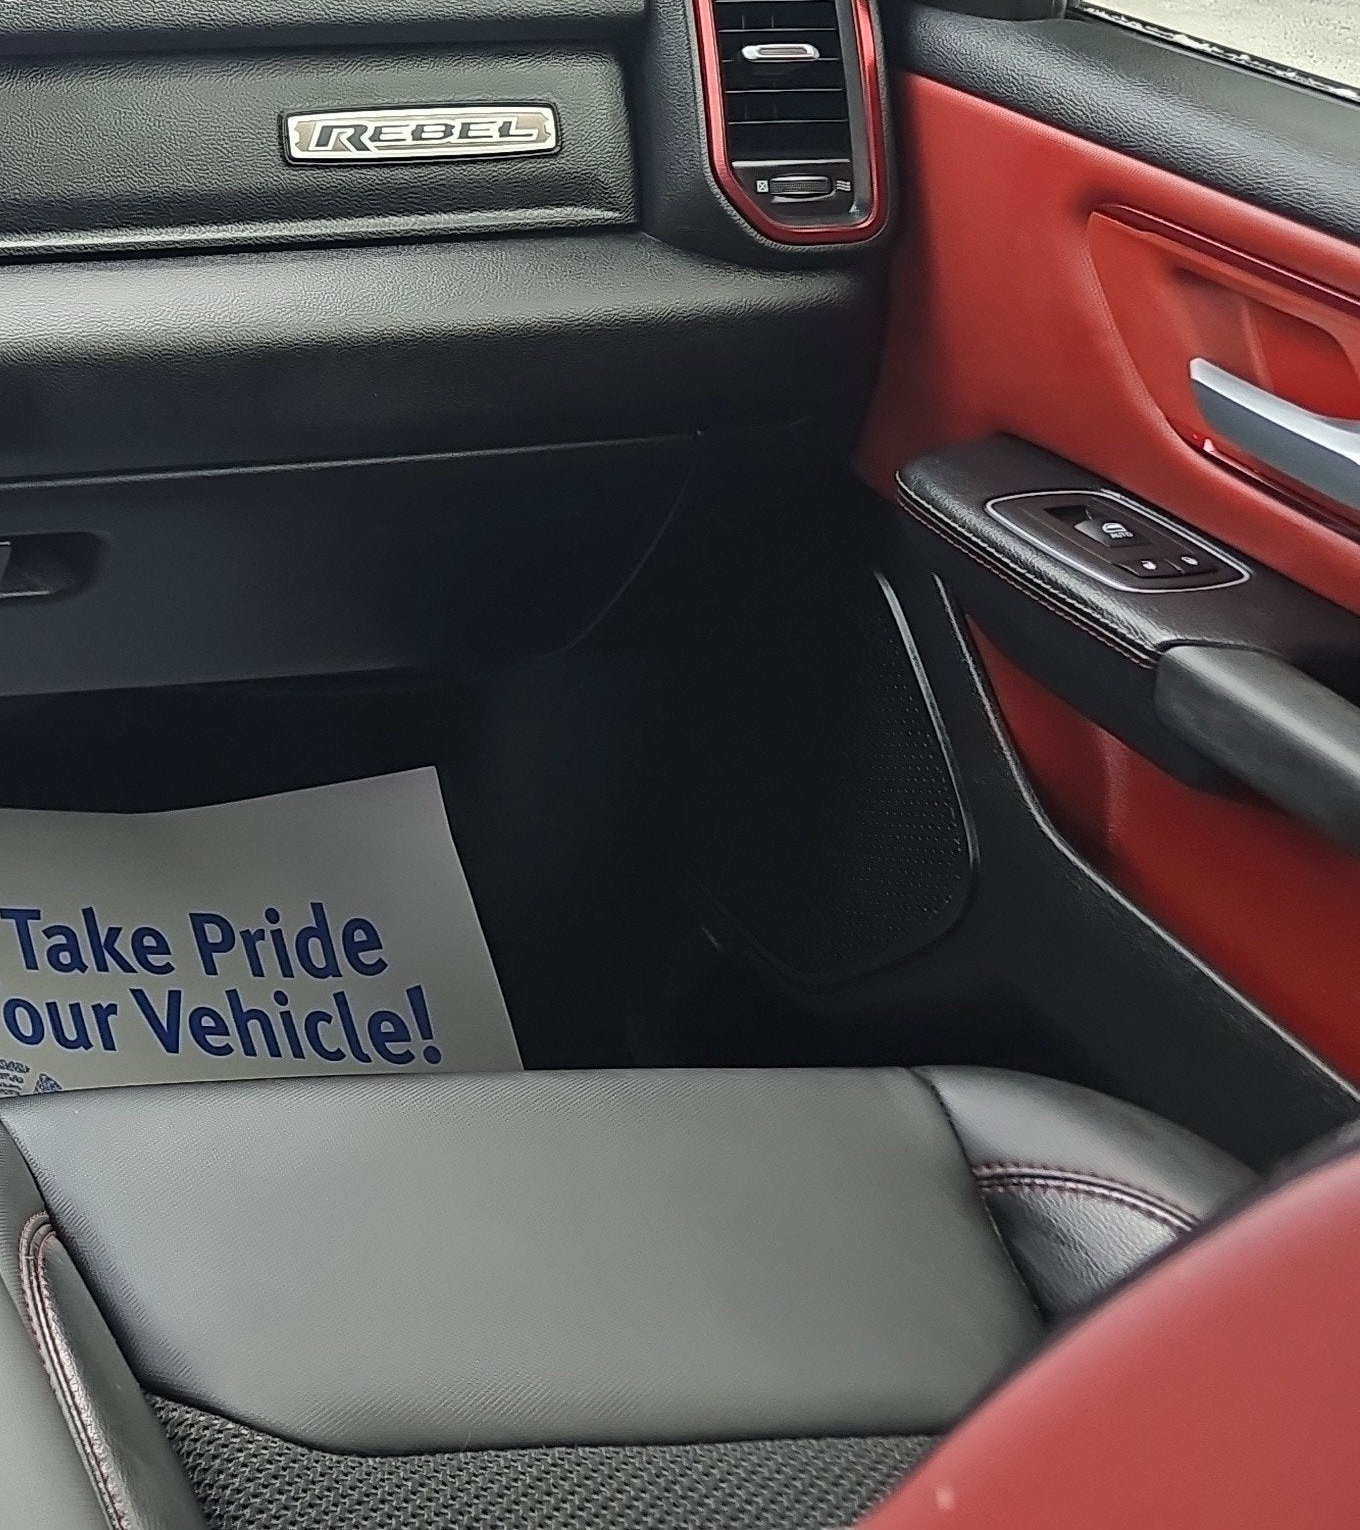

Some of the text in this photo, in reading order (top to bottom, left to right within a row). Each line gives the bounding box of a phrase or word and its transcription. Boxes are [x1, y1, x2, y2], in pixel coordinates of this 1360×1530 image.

[307, 117, 539, 153] REBEL
[187, 901, 390, 980] Pride
[128, 983, 443, 1066] Vehicle!
